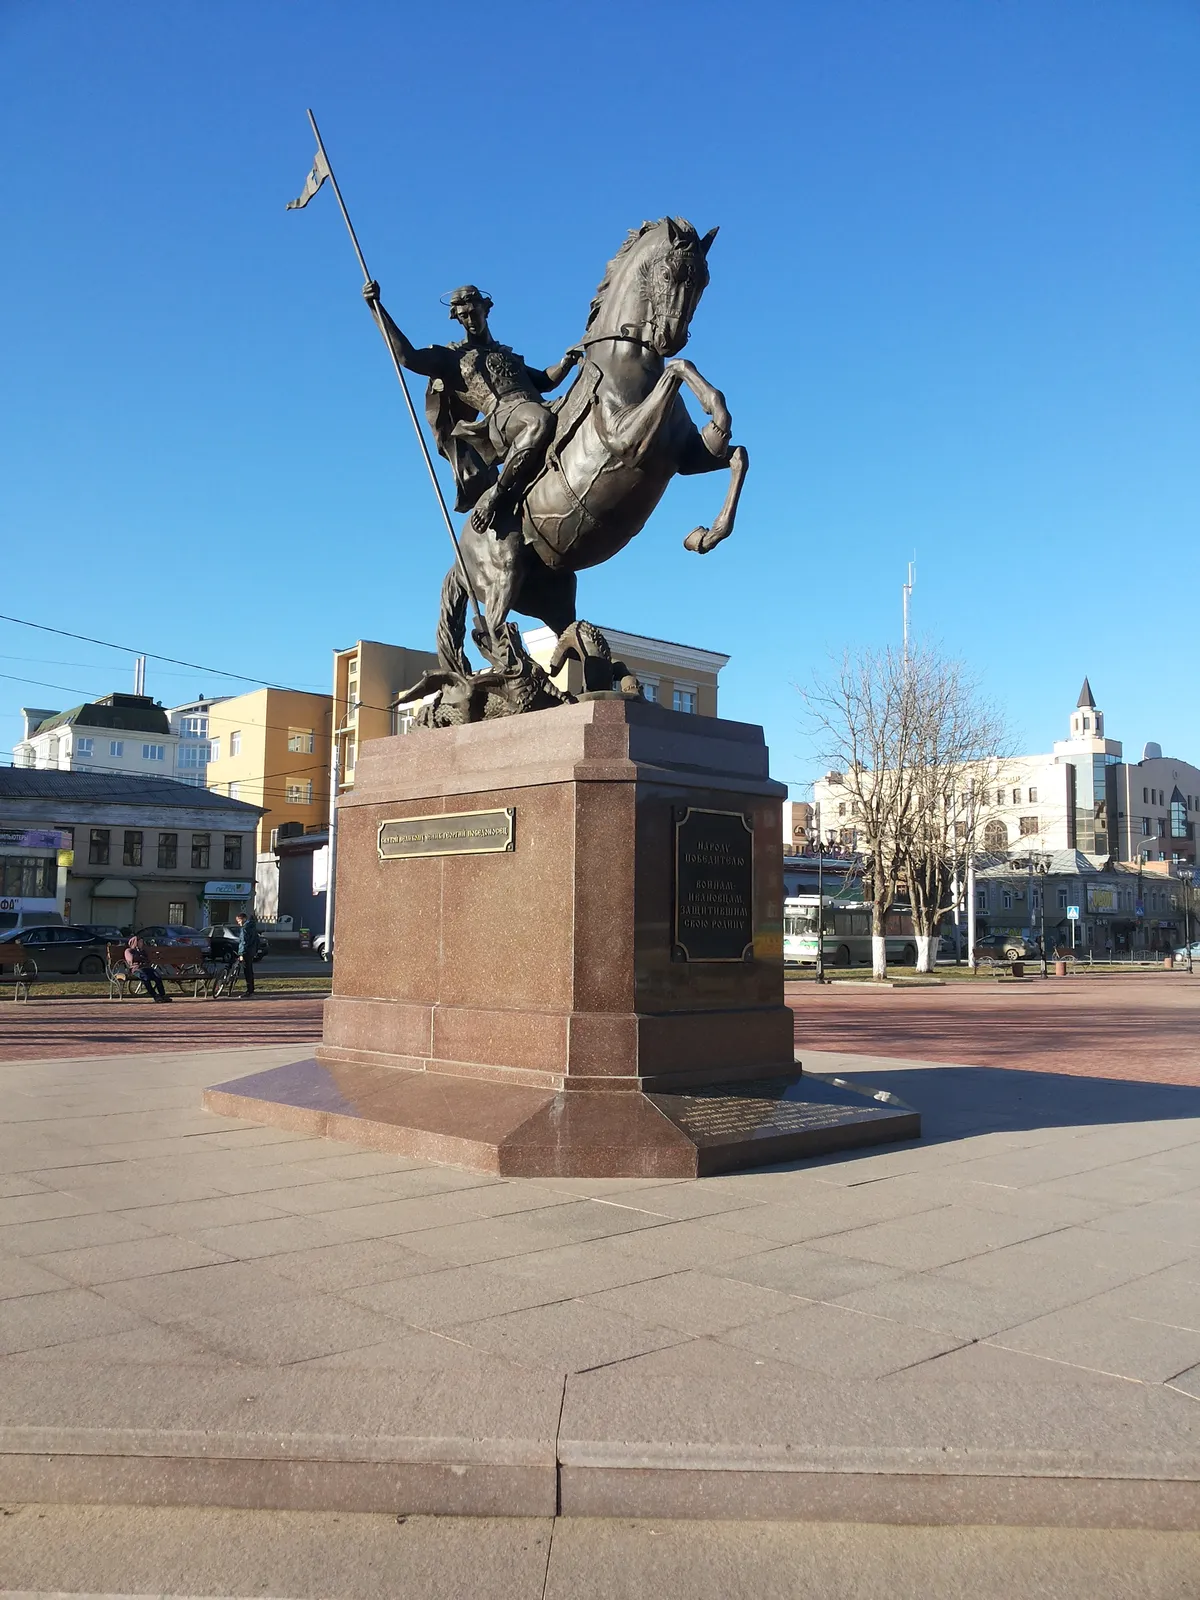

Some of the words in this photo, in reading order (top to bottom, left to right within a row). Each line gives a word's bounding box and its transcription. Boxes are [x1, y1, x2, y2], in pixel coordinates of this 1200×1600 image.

[697, 841, 731, 852] НАРОДУ
[685, 853, 745, 866] ПОБЕДИТЕЛЮ
[681, 905, 748, 916] ЗАЩИТИВШИМ
[684, 919, 709, 929] СВОЮ
[711, 919, 745, 930] РОДИНУ
